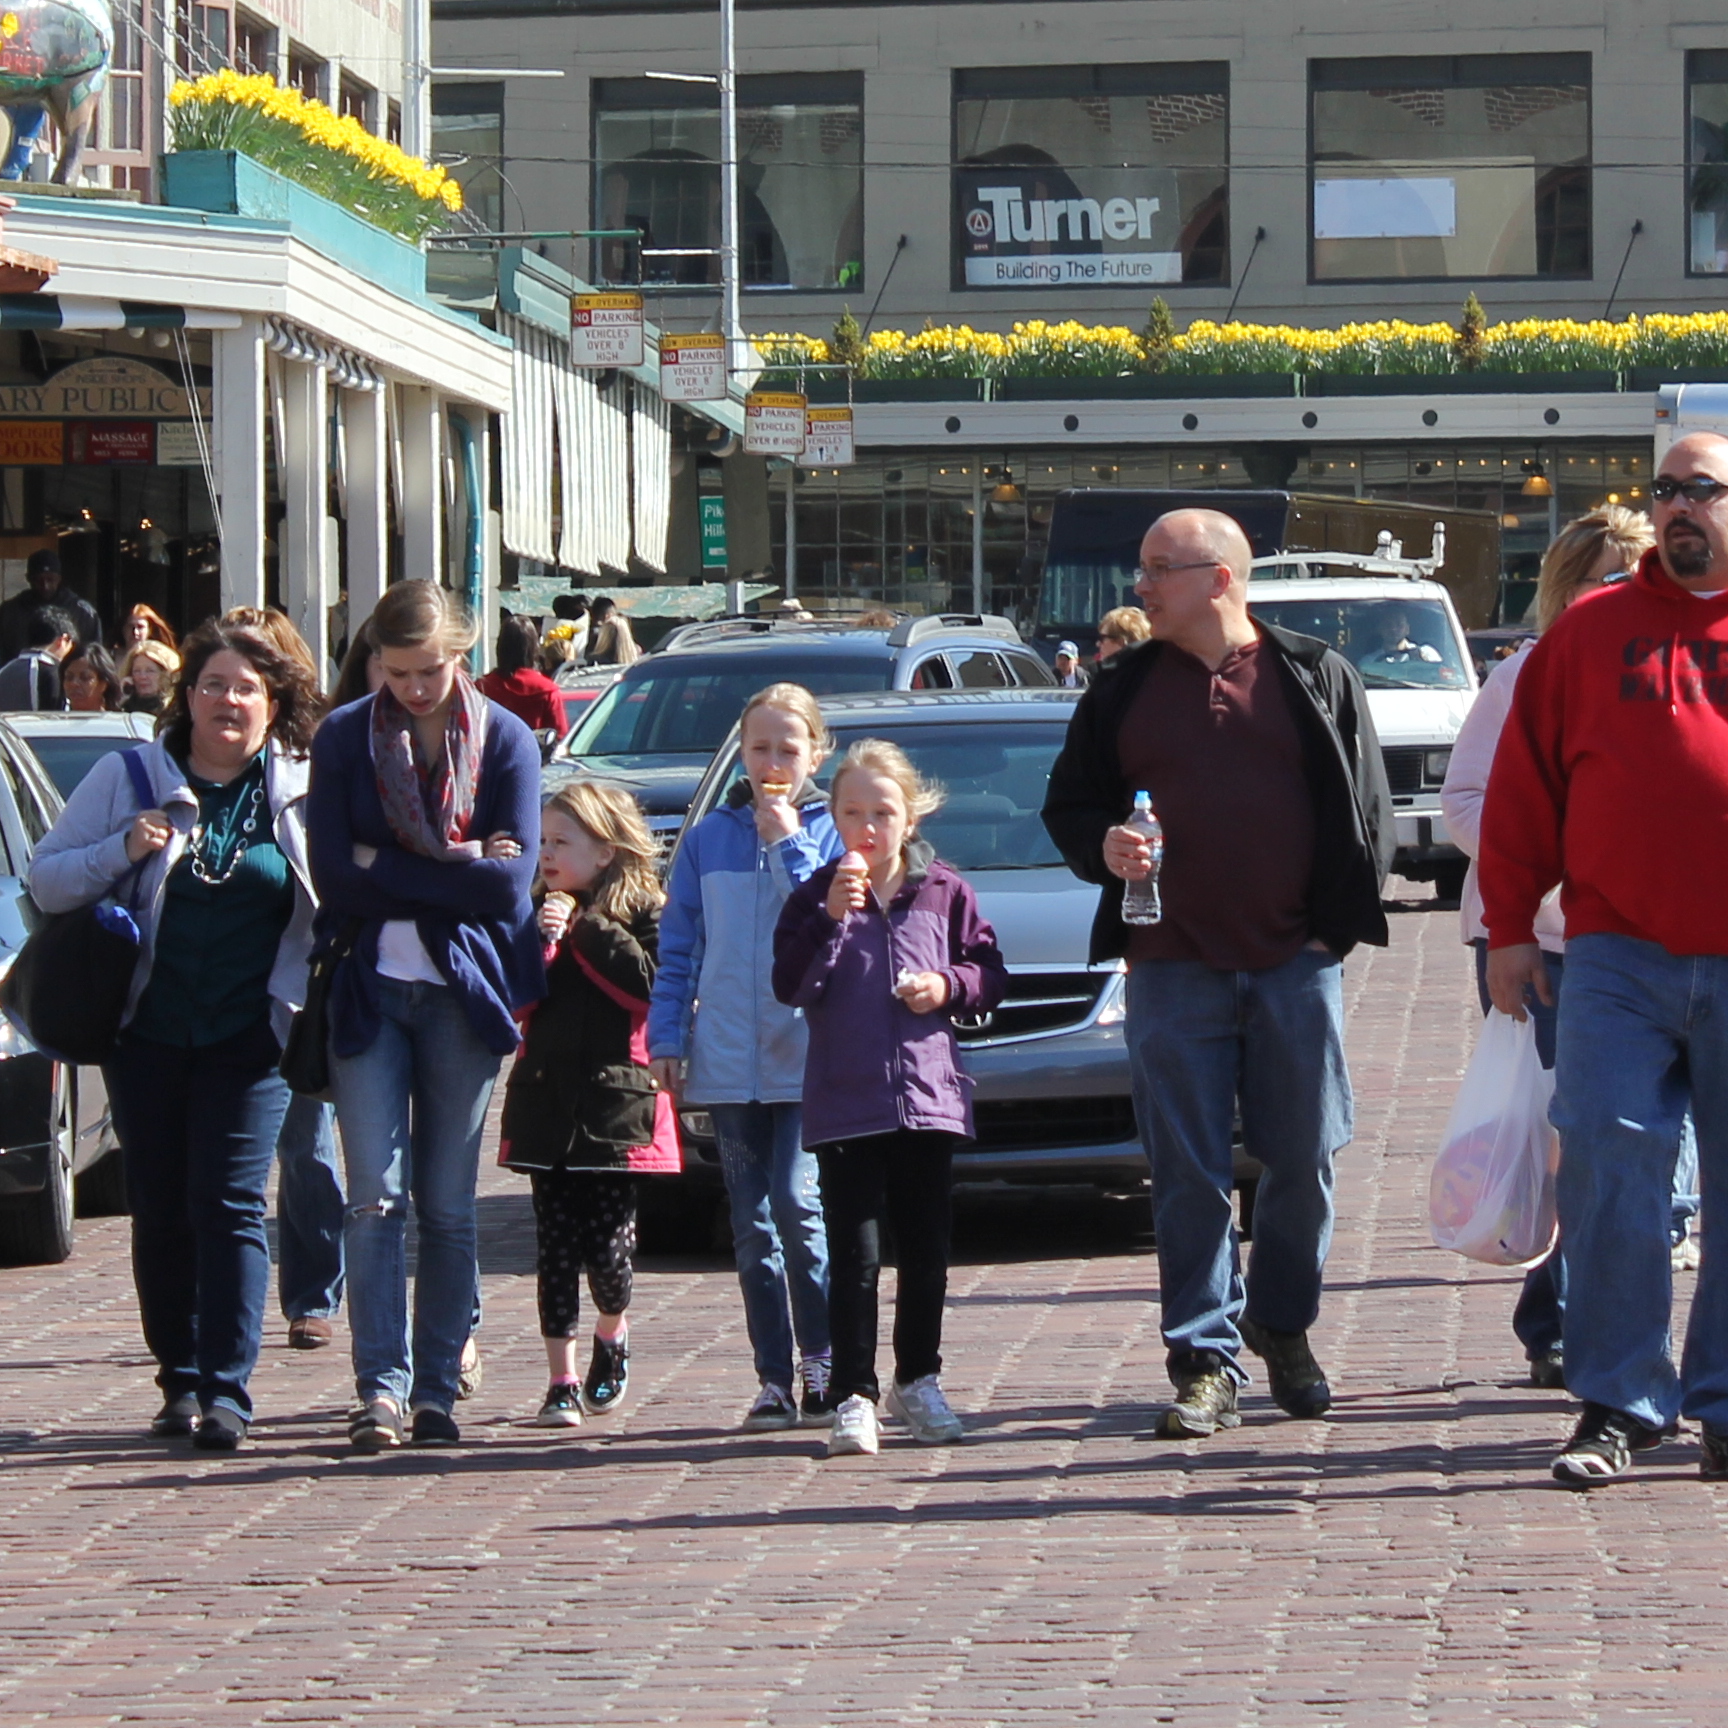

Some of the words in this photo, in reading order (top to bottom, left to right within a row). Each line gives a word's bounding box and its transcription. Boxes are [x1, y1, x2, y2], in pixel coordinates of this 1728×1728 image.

[977, 186, 1161, 243] Turner
[996, 261, 1061, 282] Building
[1066, 260, 1096, 280] The
[1101, 259, 1153, 278] Future
[574, 312, 589, 323] NO
[594, 312, 642, 323] PARKING
[584, 328, 630, 339] VEHICLES
[587, 339, 612, 350] OVER
[596, 351, 620, 362] HIGH
[662, 351, 676, 362] NO
[680, 350, 723, 361] PARKING
[673, 366, 714, 376] VEHICLES
[675, 377, 697, 387] OVER
[683, 387, 705, 397] HIGH
[61, 387, 179, 413] PUBLIC
[765, 409, 801, 419] PARKING
[755, 423, 796, 432] VEHICLES
[813, 423, 850, 432] PARKING
[91, 432, 149, 444] MASSAGE
[704, 523, 726, 537] Hill
